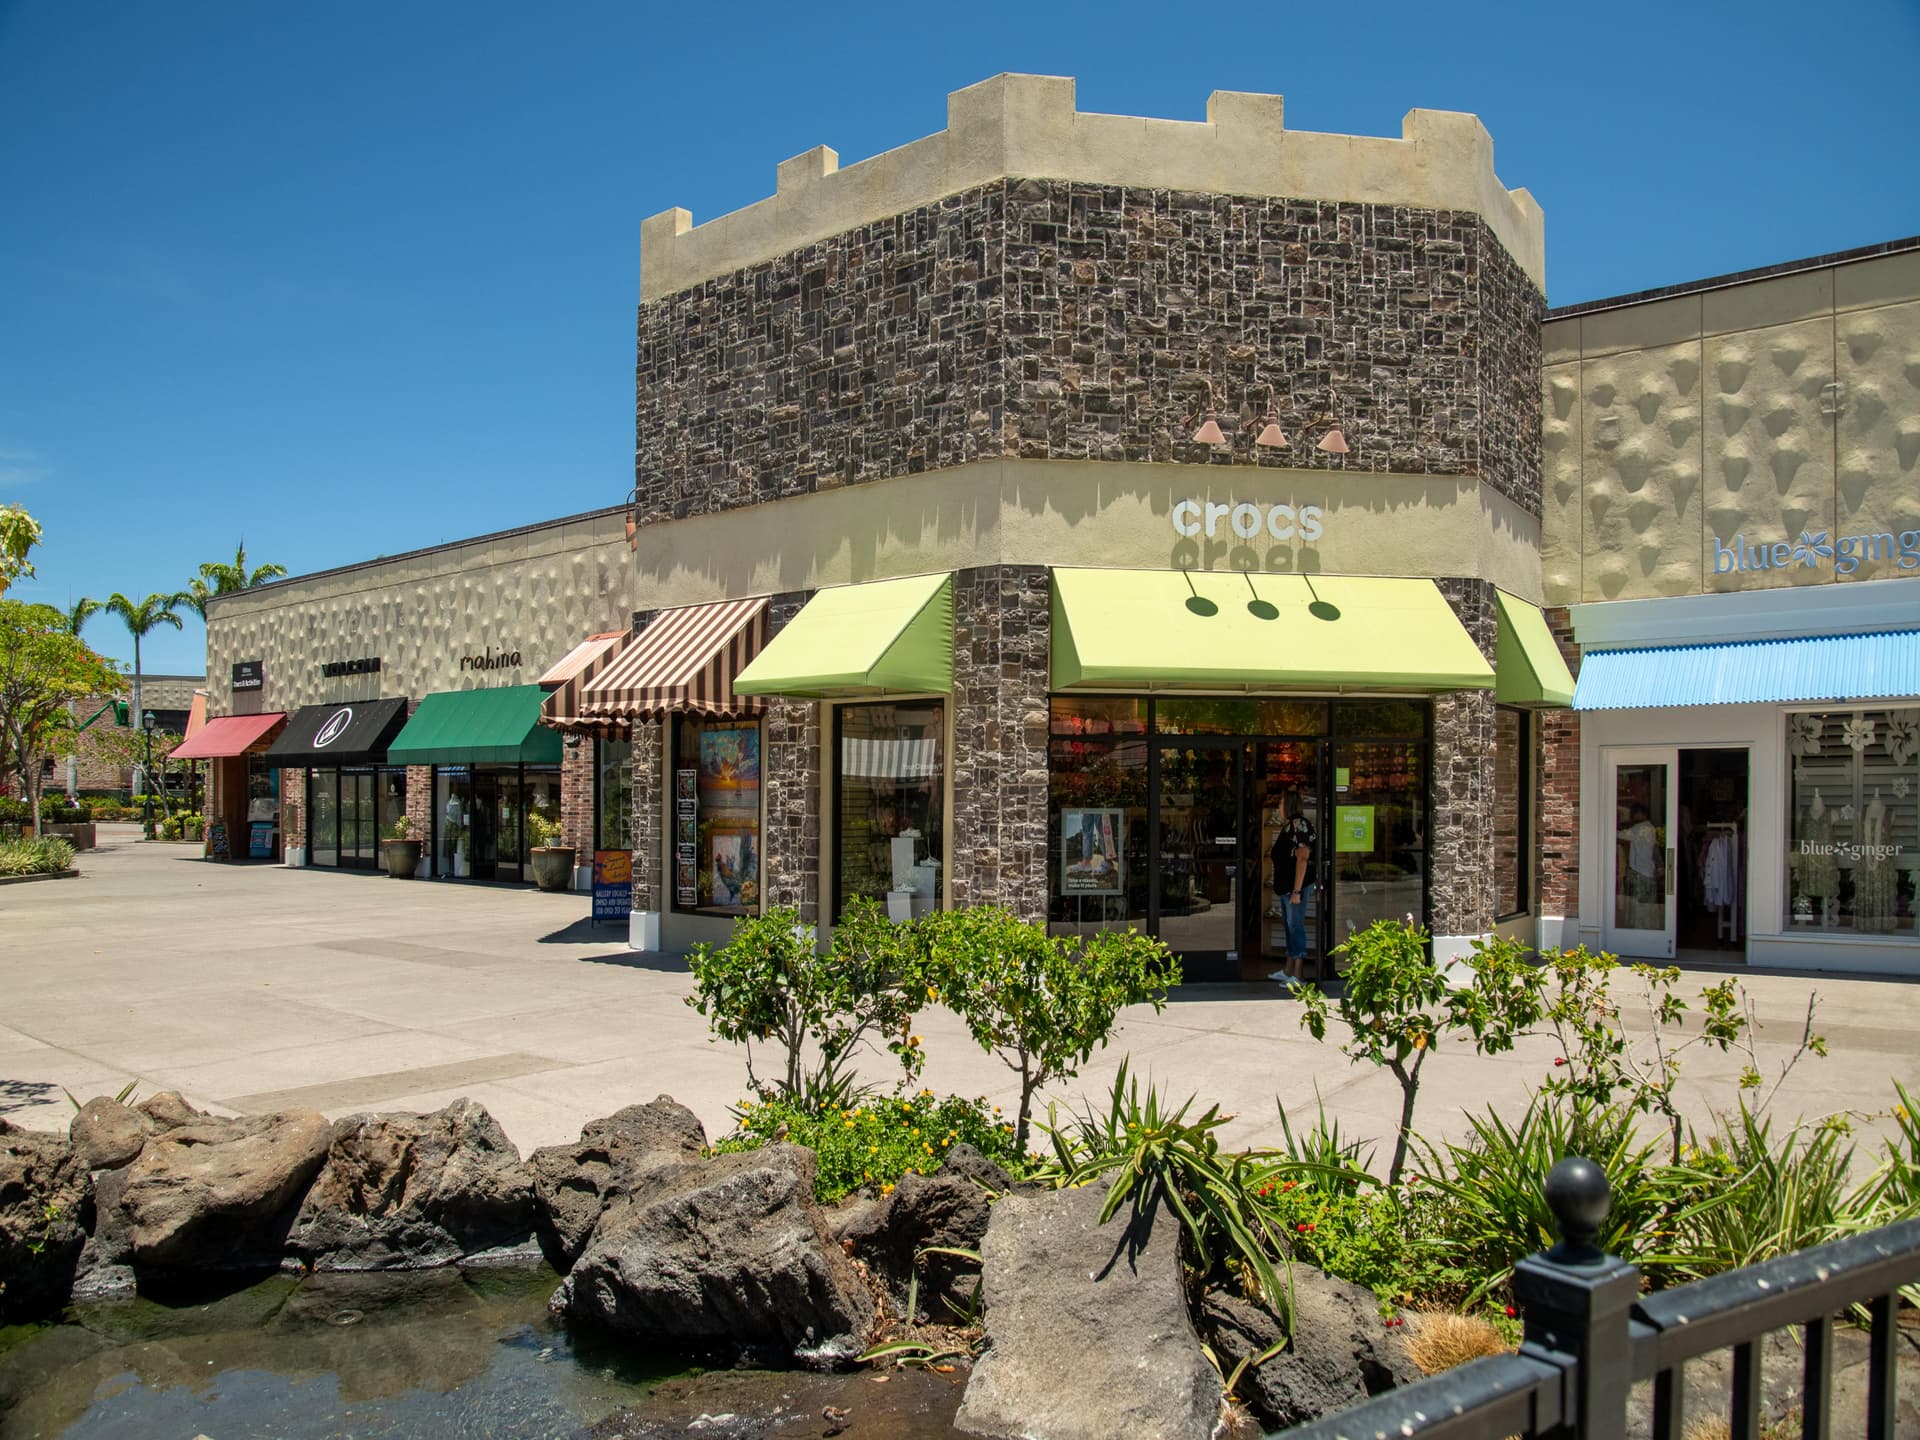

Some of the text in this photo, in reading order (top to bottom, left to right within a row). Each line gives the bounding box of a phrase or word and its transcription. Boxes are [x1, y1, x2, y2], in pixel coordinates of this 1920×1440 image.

[1172, 500, 1323, 541] crocs
[1713, 534, 1792, 574] blue
[460, 646, 523, 671] mahina
[1801, 840, 1903, 861] blue ginger
